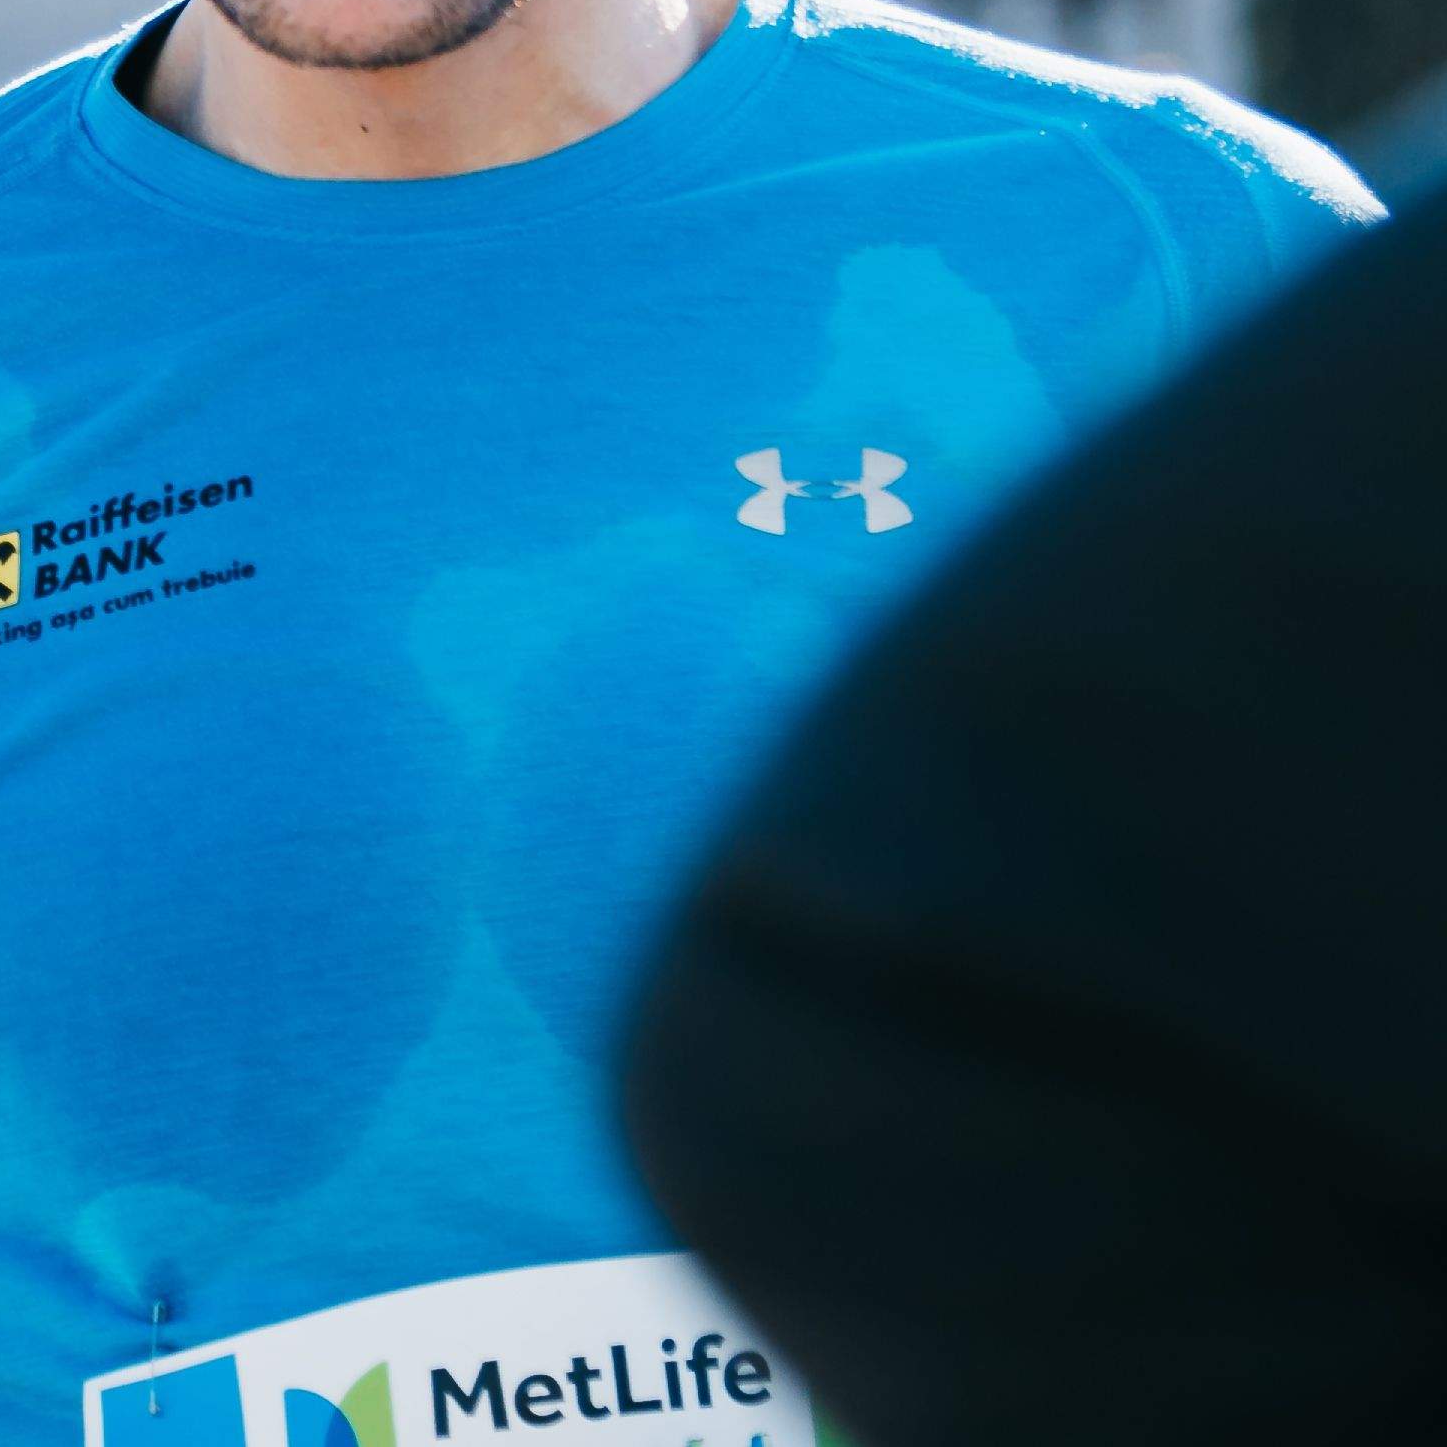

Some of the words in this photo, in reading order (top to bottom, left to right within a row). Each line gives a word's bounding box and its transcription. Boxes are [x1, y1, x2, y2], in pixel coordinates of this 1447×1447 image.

[31, 474, 253, 553] Raiffeisen
[34, 530, 167, 600] BANK
[103, 589, 155, 614] cum
[161, 559, 257, 598] trebuie
[430, 1332, 772, 1439] MetLife
